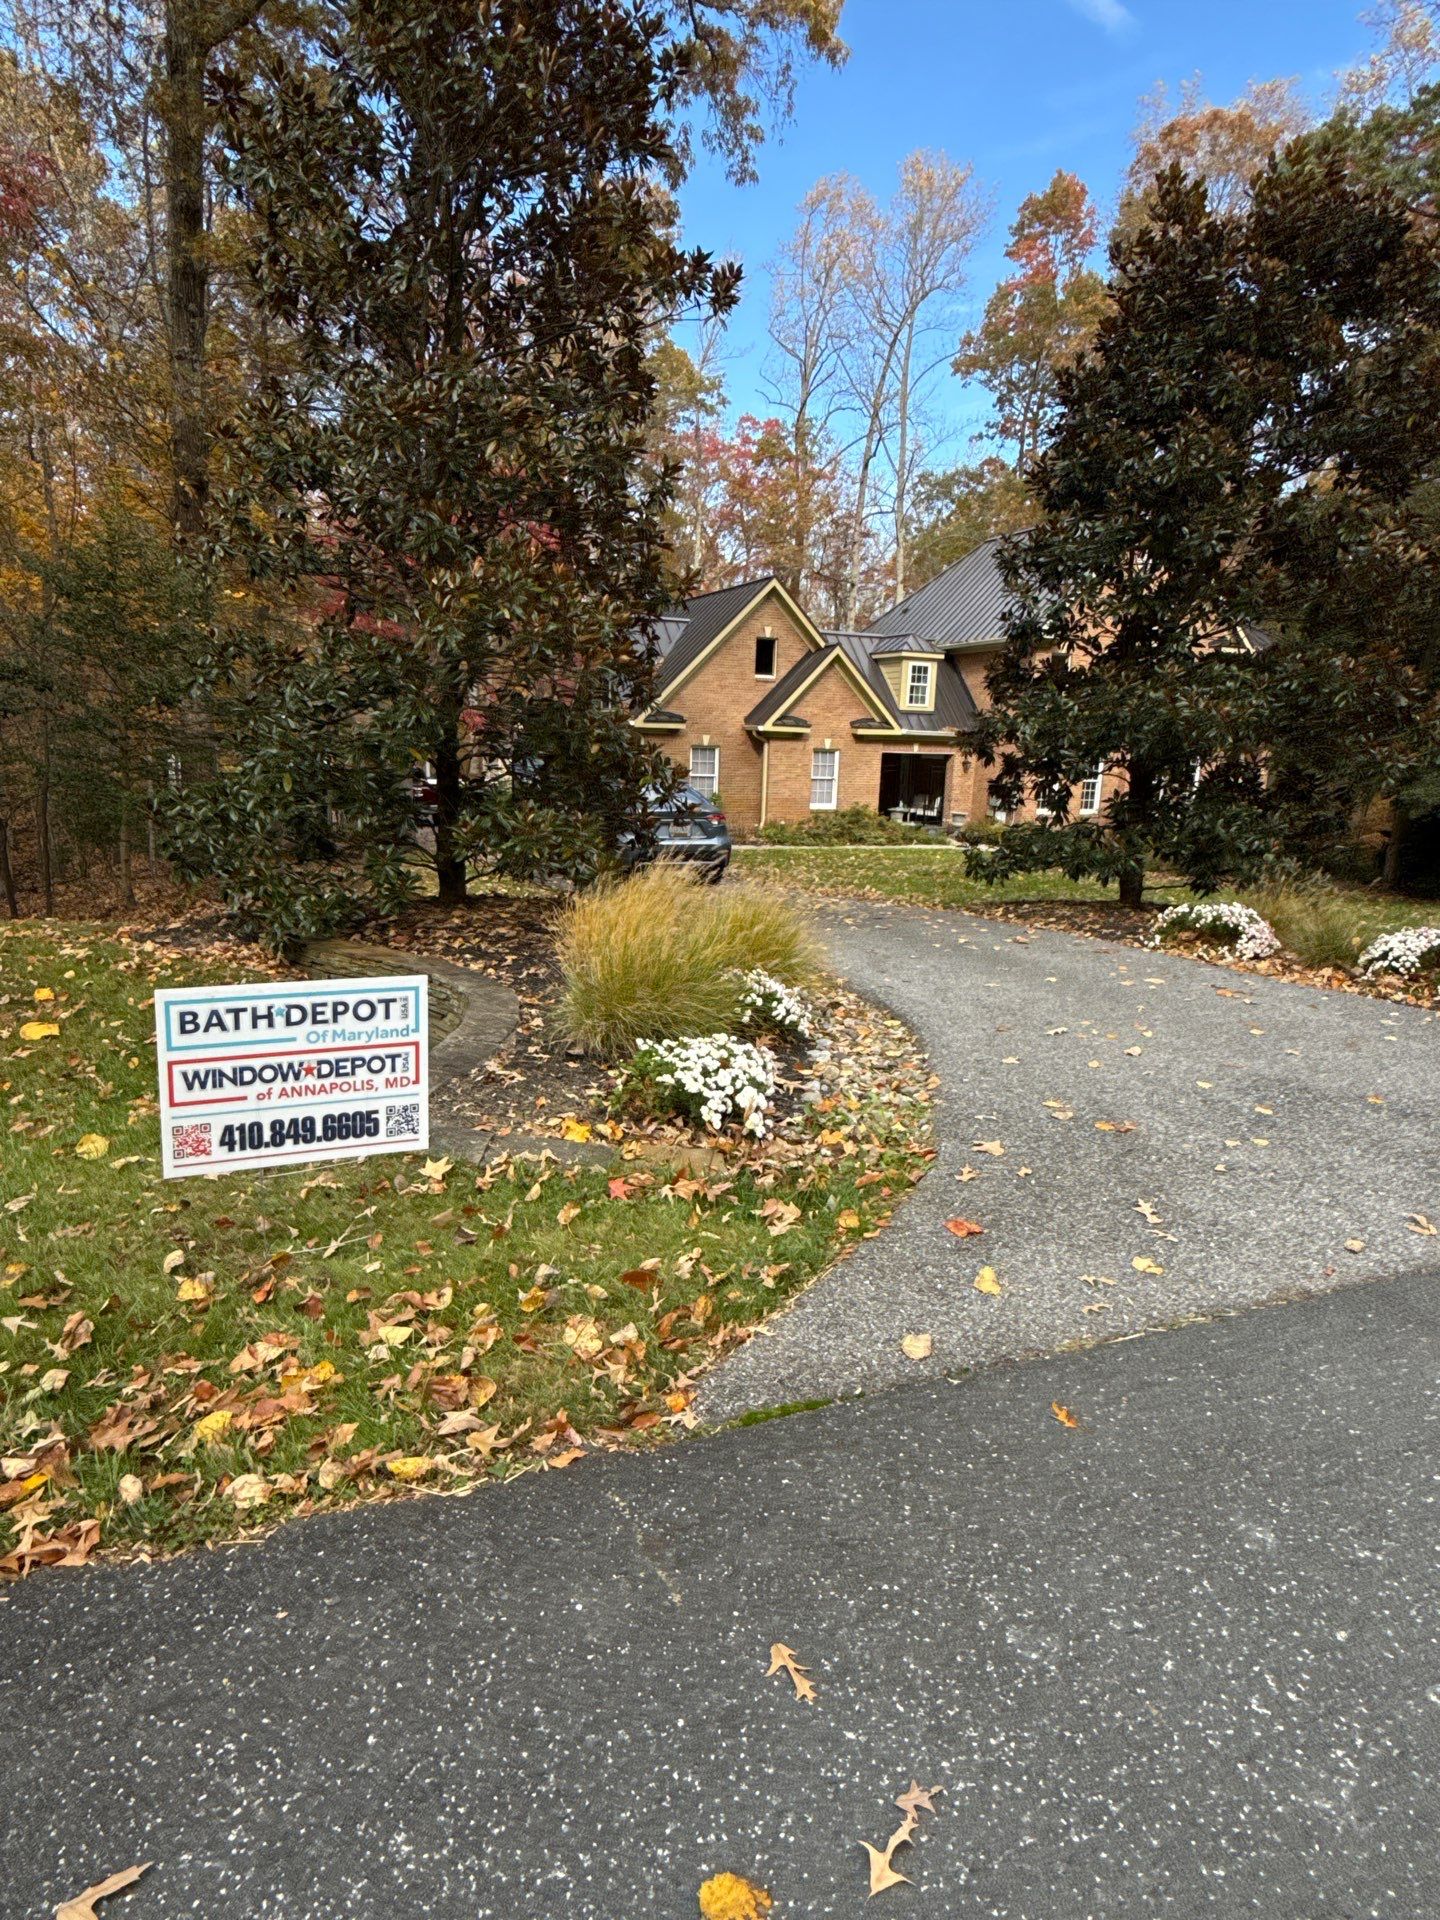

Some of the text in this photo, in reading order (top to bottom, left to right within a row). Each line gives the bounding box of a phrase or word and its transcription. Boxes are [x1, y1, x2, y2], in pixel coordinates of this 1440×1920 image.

[179, 998, 397, 1035] BATH DEPOT
[306, 1025, 409, 1044] Of Maryland
[182, 1053, 402, 1091] WINDOW DEPOT
[256, 1076, 410, 1101] of ANNAPOLIS, MD
[219, 1110, 380, 1152] 410.849.6605
